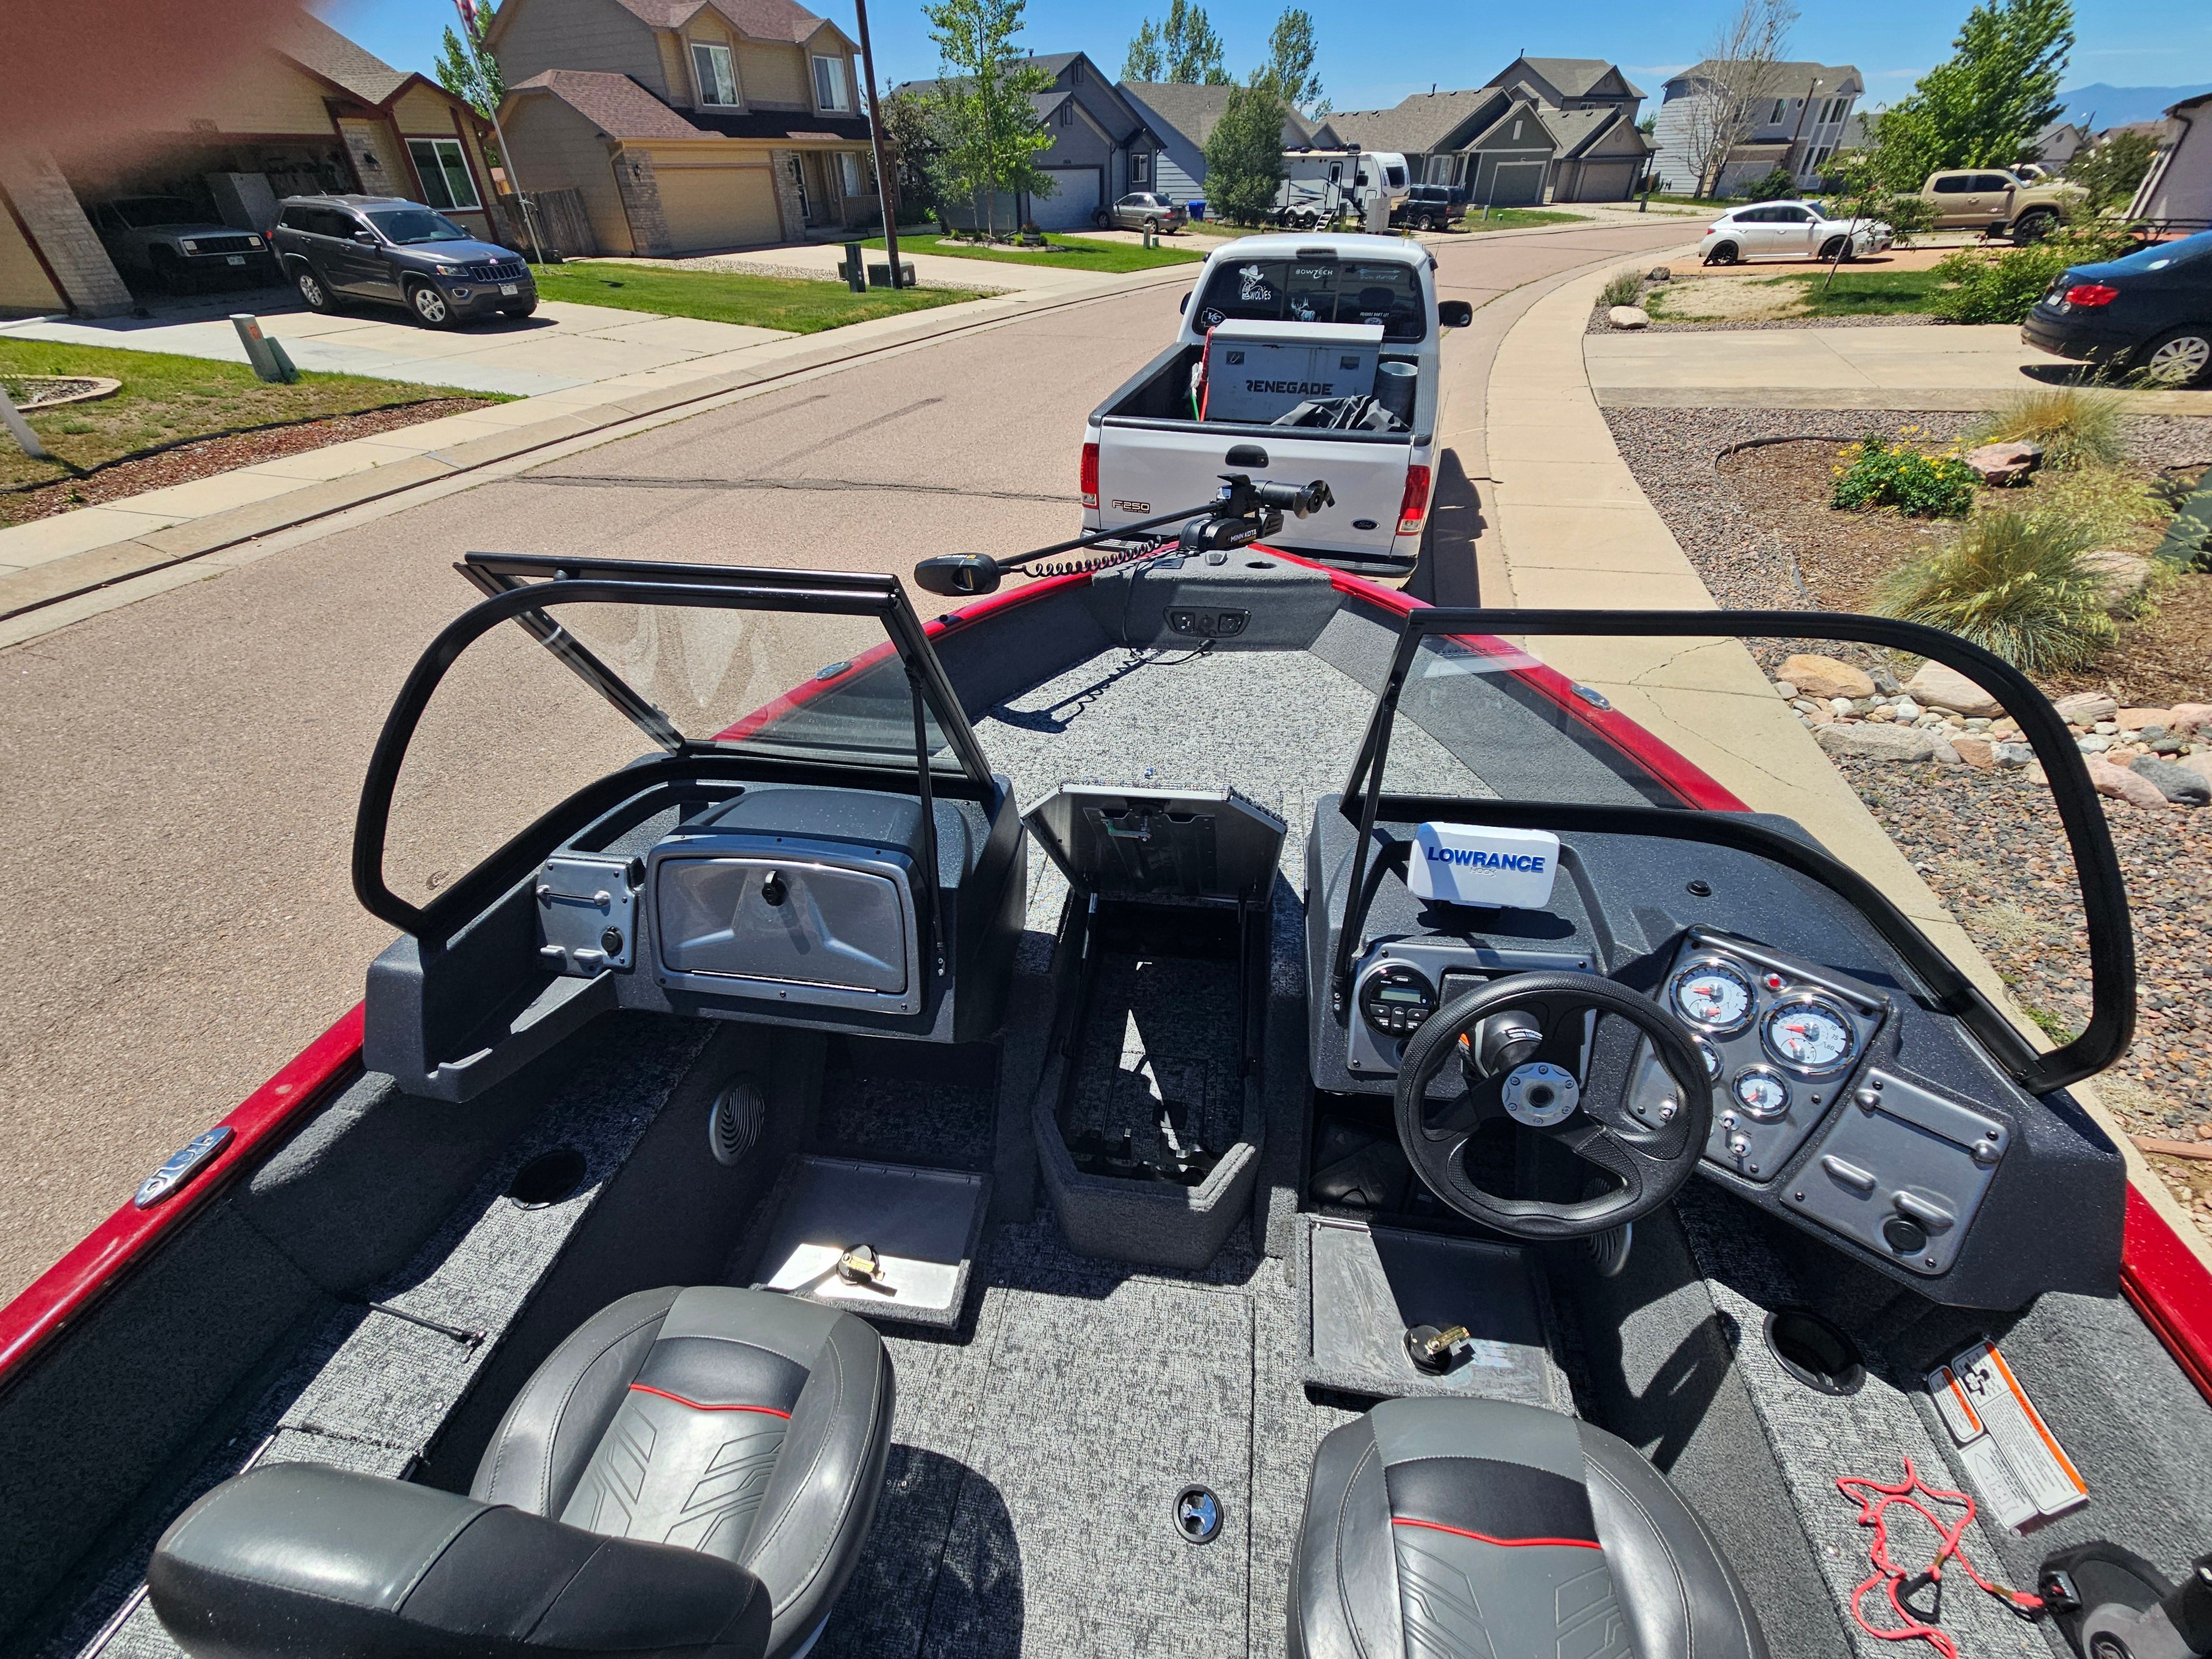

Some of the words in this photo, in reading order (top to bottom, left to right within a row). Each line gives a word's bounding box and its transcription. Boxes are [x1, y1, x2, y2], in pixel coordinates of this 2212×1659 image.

[1295, 266, 1333, 279] BOWTECH
[1250, 291, 1271, 300] WOLVES
[1245, 380, 1334, 396] RENEGADE
[1230, 533, 1244, 542] MINN
[1244, 529, 1257, 538] KOTA
[1427, 846, 1546, 873] LOWRANCE
